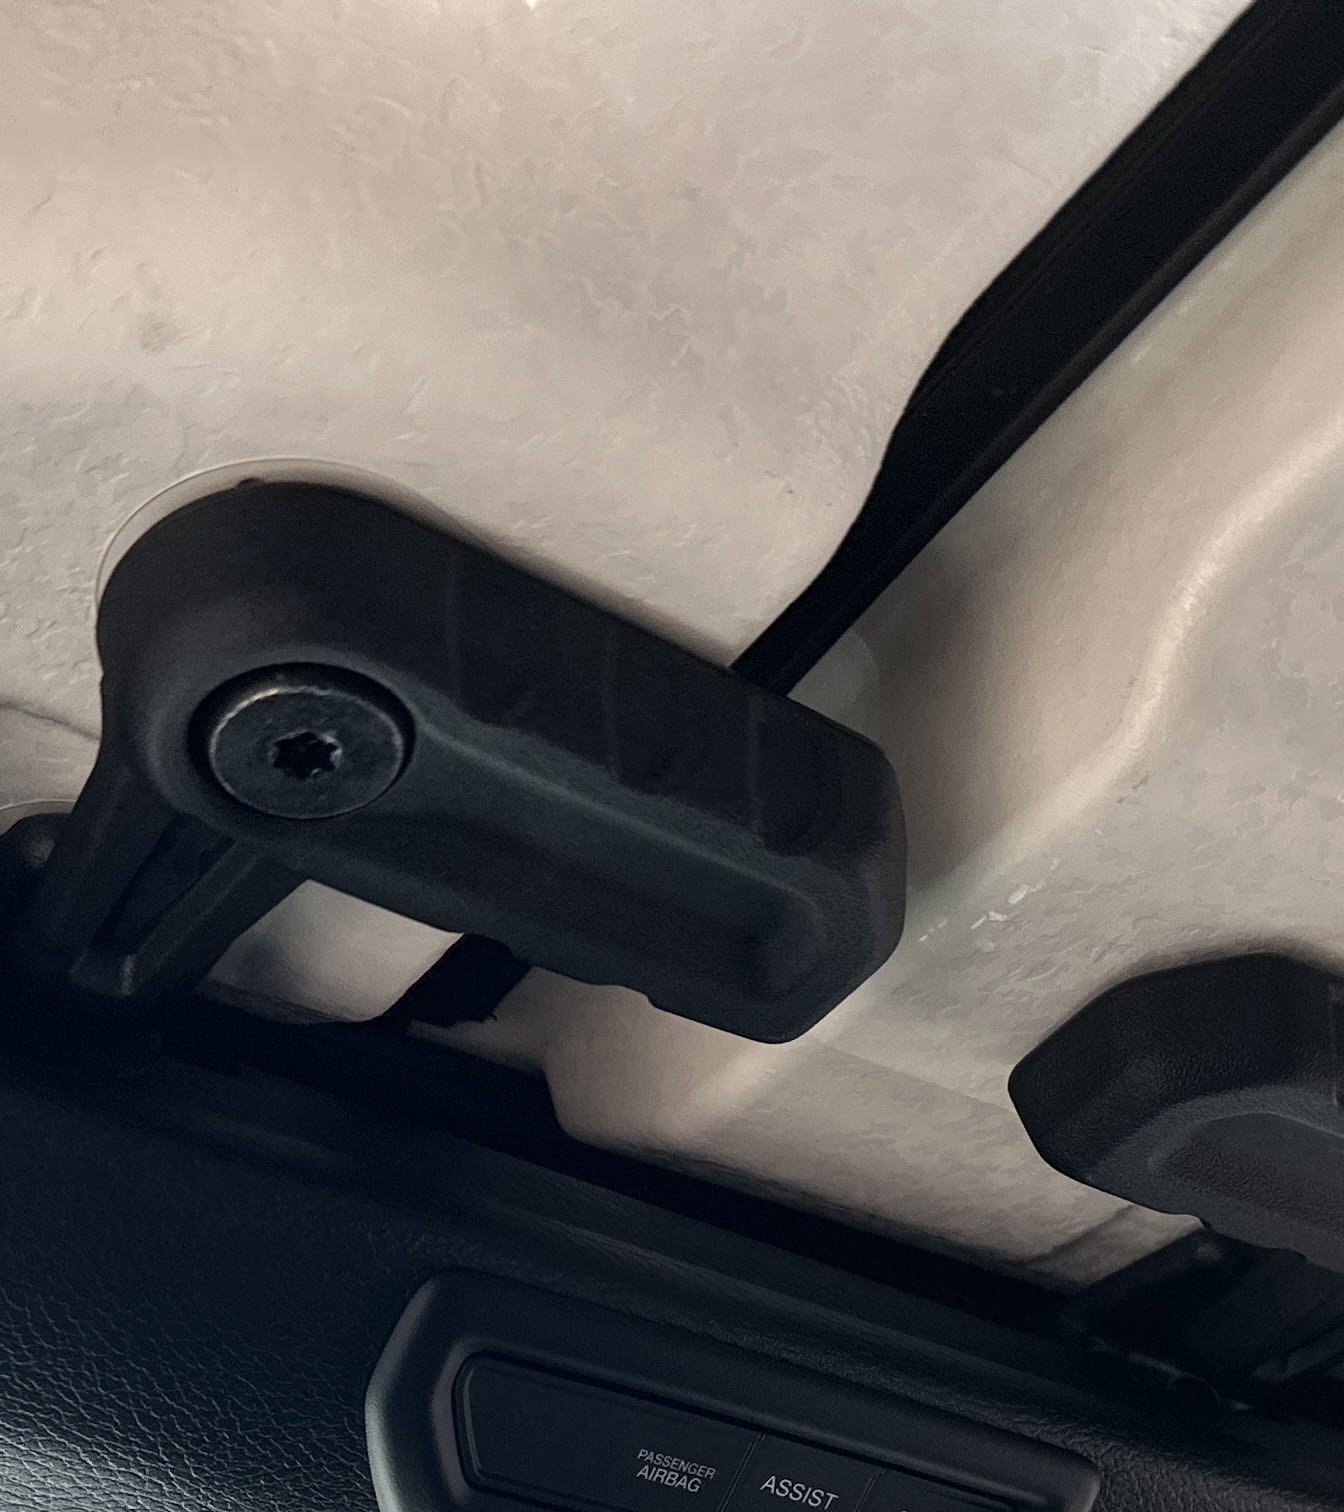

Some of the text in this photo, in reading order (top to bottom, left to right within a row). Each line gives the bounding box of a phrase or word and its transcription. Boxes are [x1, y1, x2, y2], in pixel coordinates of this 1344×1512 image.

[636, 1465, 702, 1493] AIRBAG
[637, 1449, 716, 1480] PASSENGER
[760, 1475, 840, 1511] ASSIST
